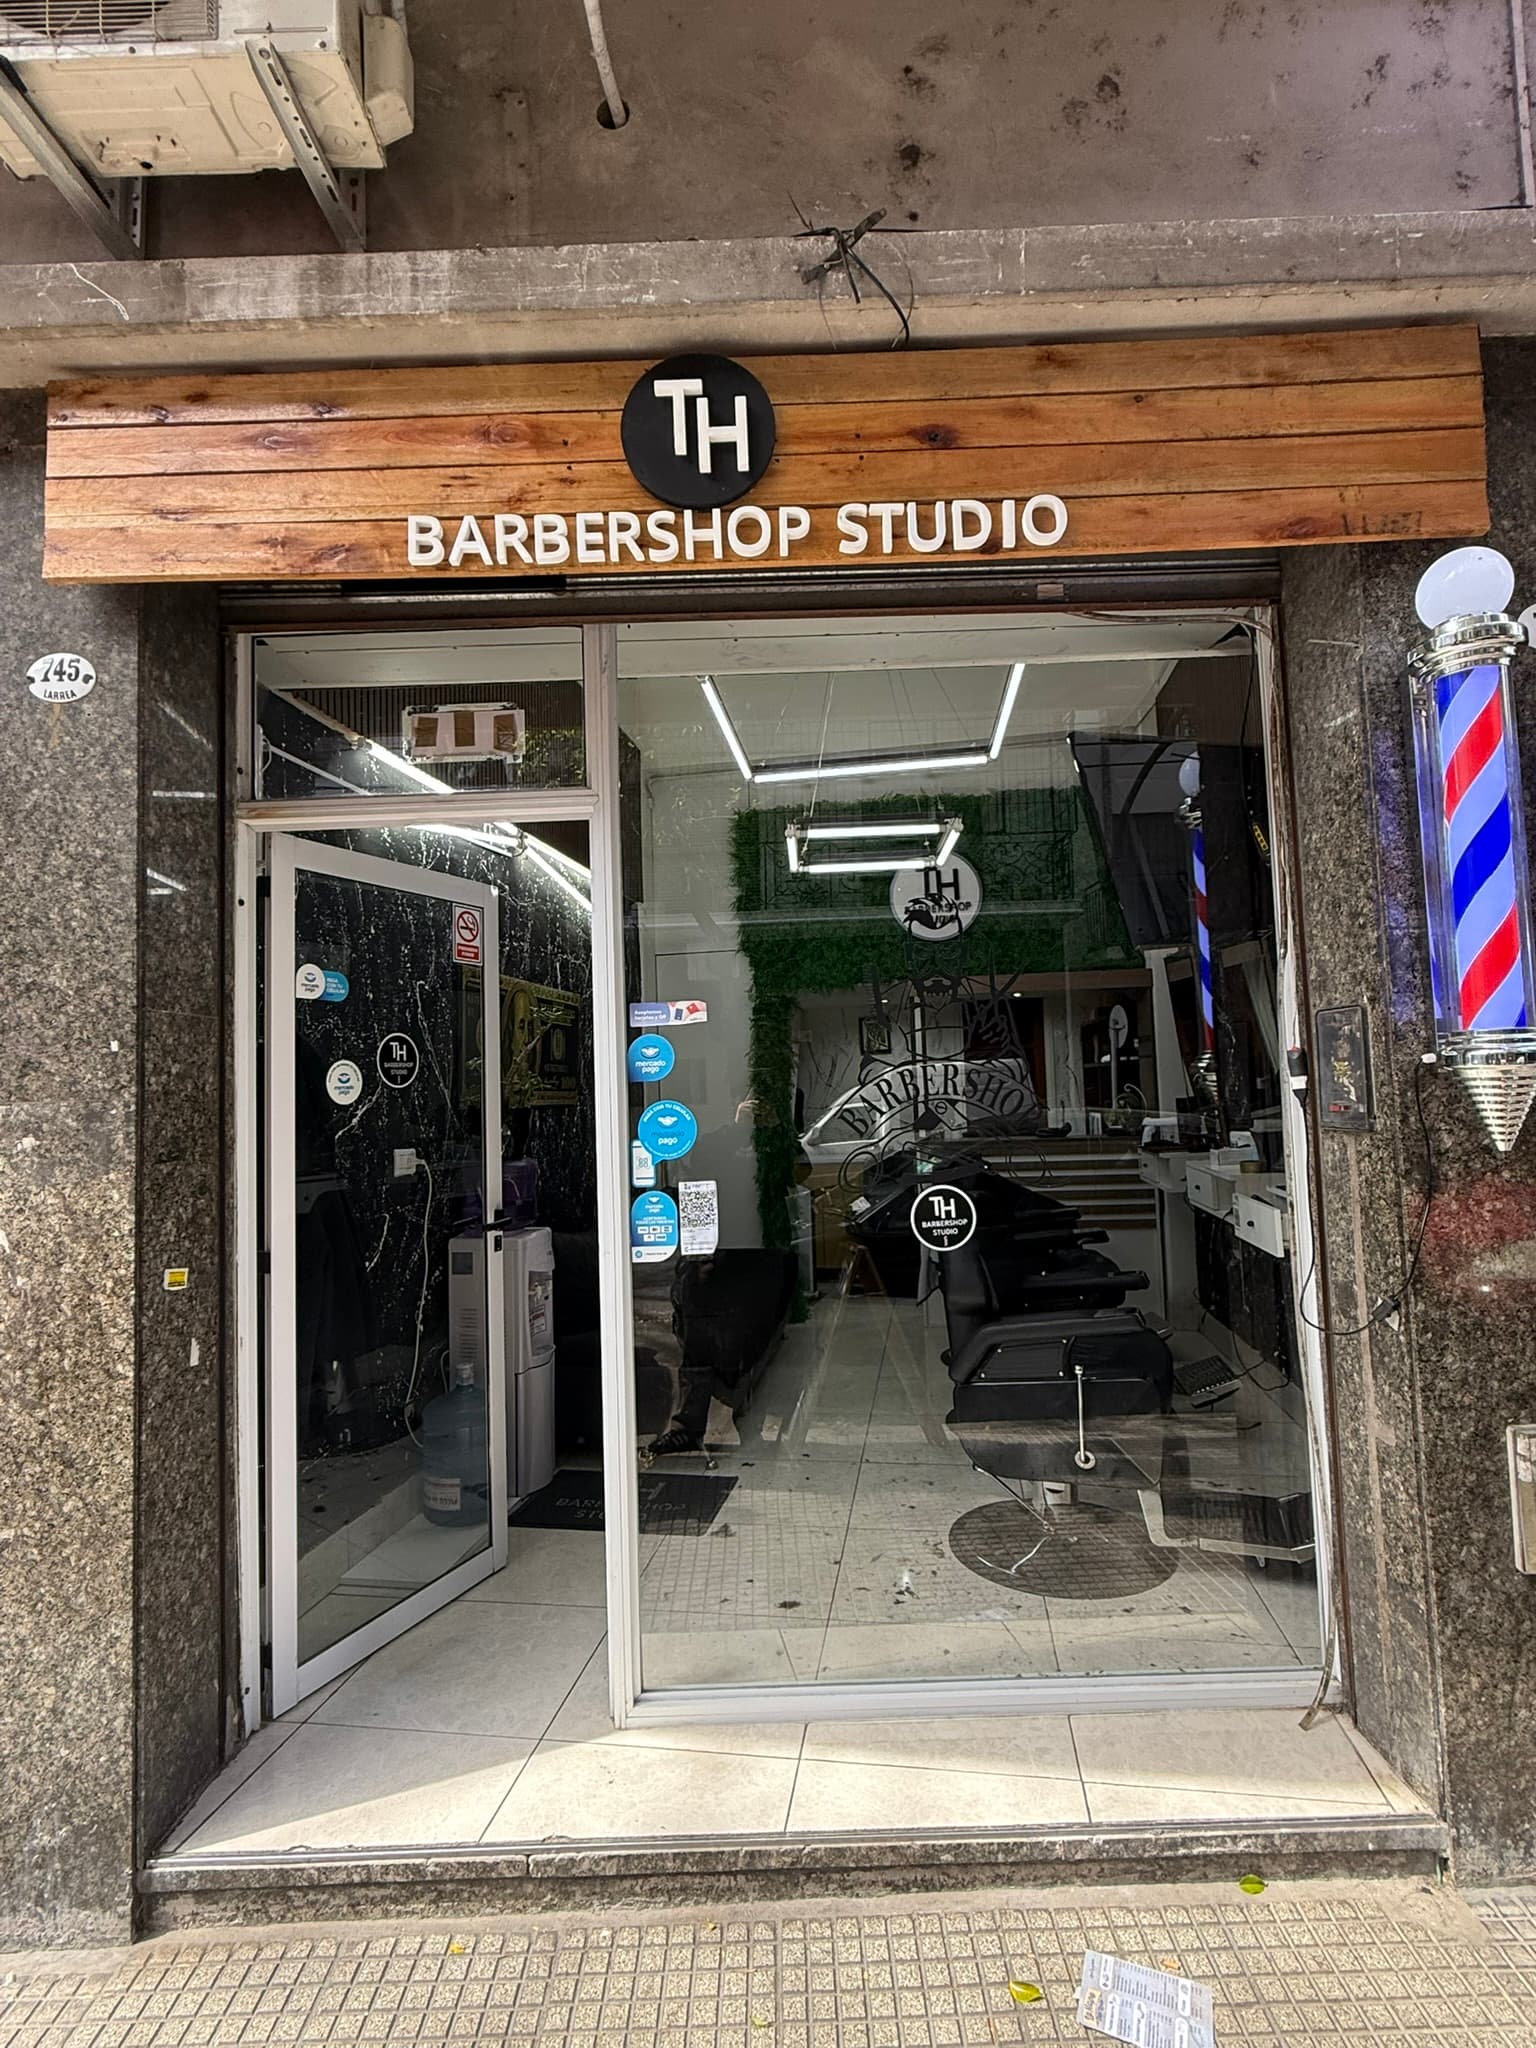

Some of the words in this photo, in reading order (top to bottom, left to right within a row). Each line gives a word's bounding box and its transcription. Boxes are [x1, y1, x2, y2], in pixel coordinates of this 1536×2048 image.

[653, 378, 750, 474] TH
[406, 505, 811, 567] BARBERSHOP
[836, 493, 1069, 555] STUDIO
[41, 657, 81, 683] 745
[43, 689, 78, 700] LARREA
[389, 1042, 407, 1061] TH
[635, 1059, 666, 1067] mercado
[641, 1066, 660, 1074] pago
[657, 1136, 679, 1146] pago
[928, 1195, 956, 1219] TH
[921, 1217, 969, 1229] BARBERSHOP
[932, 1227, 959, 1237] STUDIO
